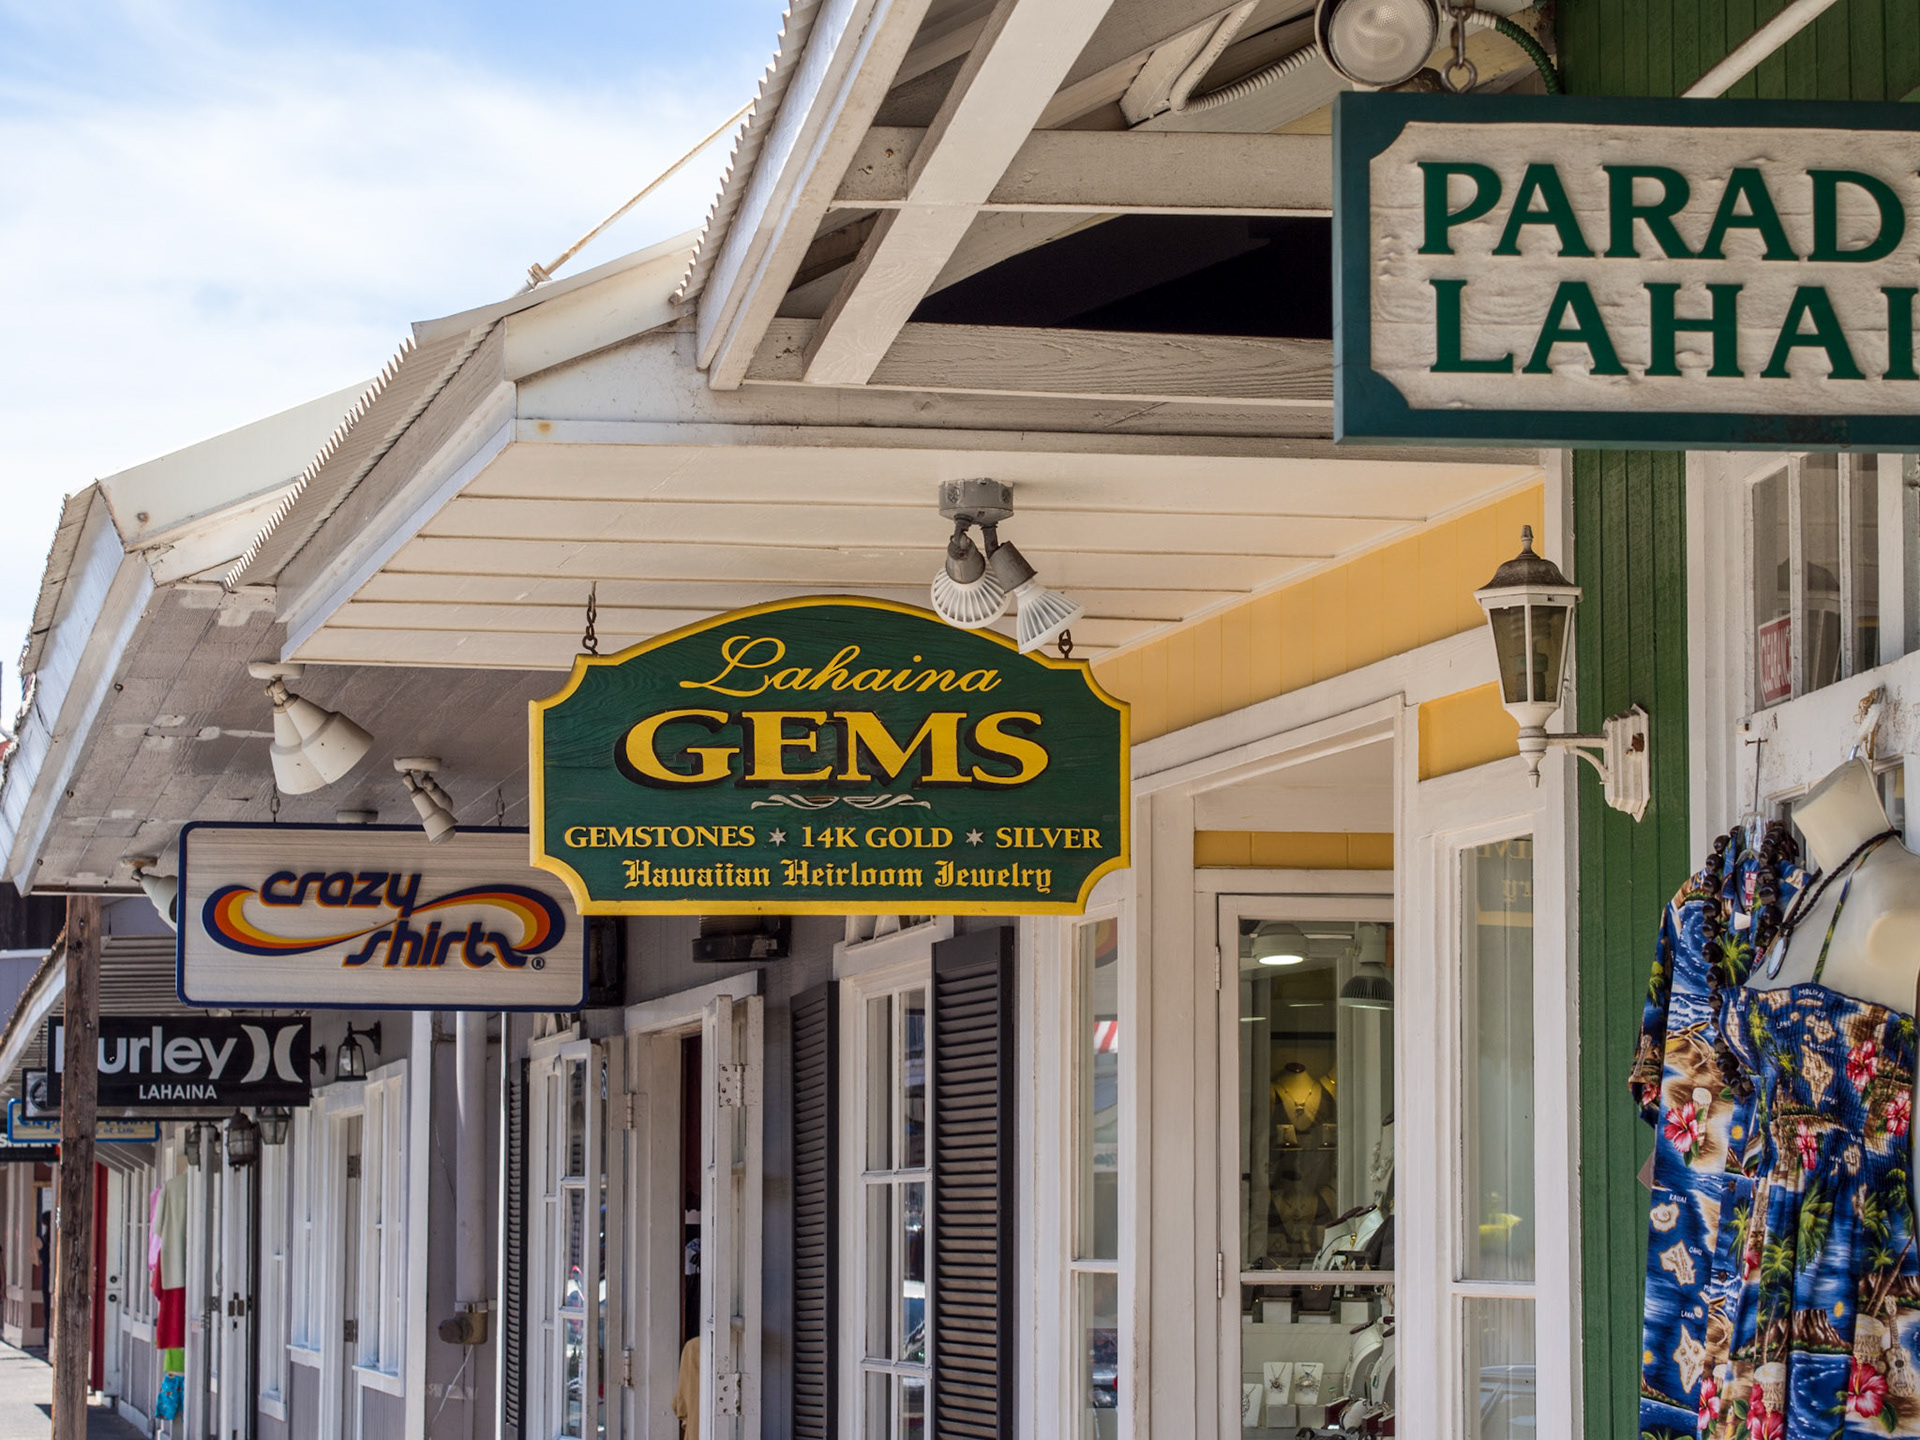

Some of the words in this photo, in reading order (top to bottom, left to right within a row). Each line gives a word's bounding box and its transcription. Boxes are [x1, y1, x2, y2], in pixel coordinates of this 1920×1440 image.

[1417, 160, 1920, 263] PARAD
[1428, 278, 1920, 381] LAHAI
[679, 635, 1003, 698] Lahaina
[616, 709, 1050, 788] GEMS
[564, 826, 756, 848] GEMSTONES
[802, 826, 859, 848] 14K
[865, 826, 954, 849] GOLD
[995, 826, 1103, 849] SILVER
[258, 871, 422, 918] crazy
[622, 859, 771, 889] Hawaiian
[780, 859, 923, 888] Heirloom
[934, 860, 1052, 893] Jewelry
[341, 921, 528, 968] shirts
[55, 1025, 237, 1080] urley
[139, 1084, 217, 1100] LAHAINA
